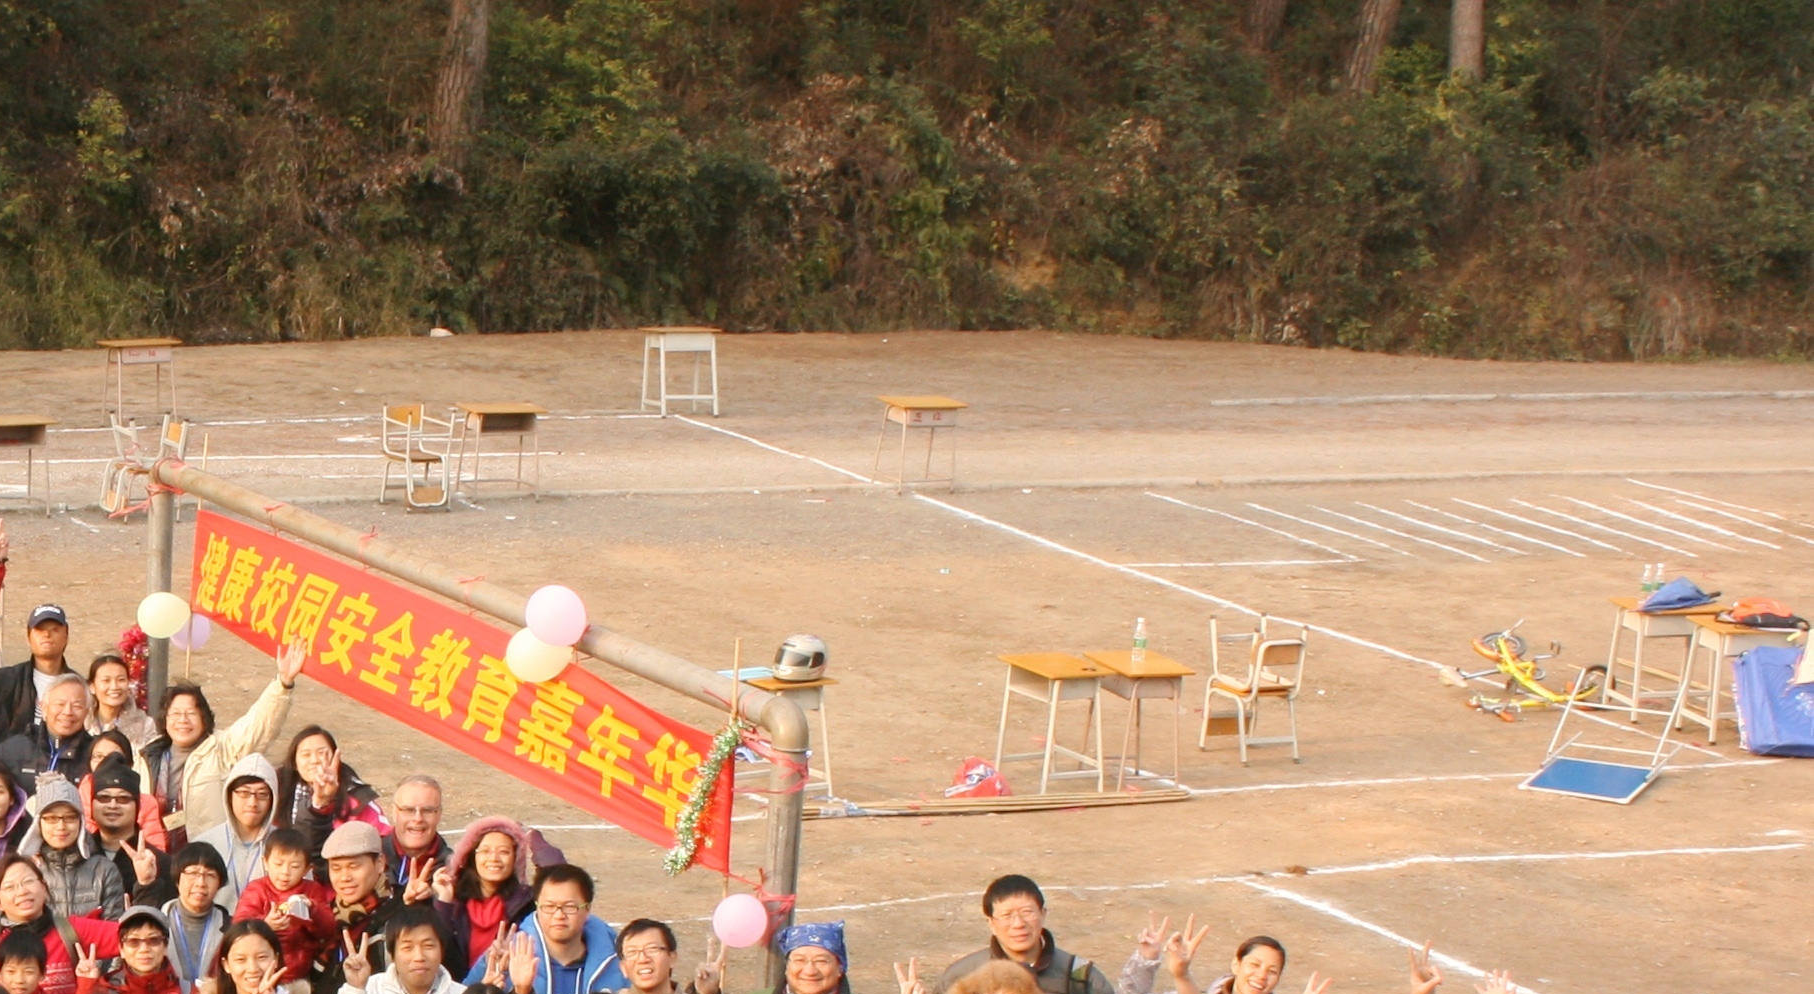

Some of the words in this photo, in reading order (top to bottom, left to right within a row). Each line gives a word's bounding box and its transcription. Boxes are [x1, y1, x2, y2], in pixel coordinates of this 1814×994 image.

[196, 532, 703, 830] 健康校园安全教育嘉年华
